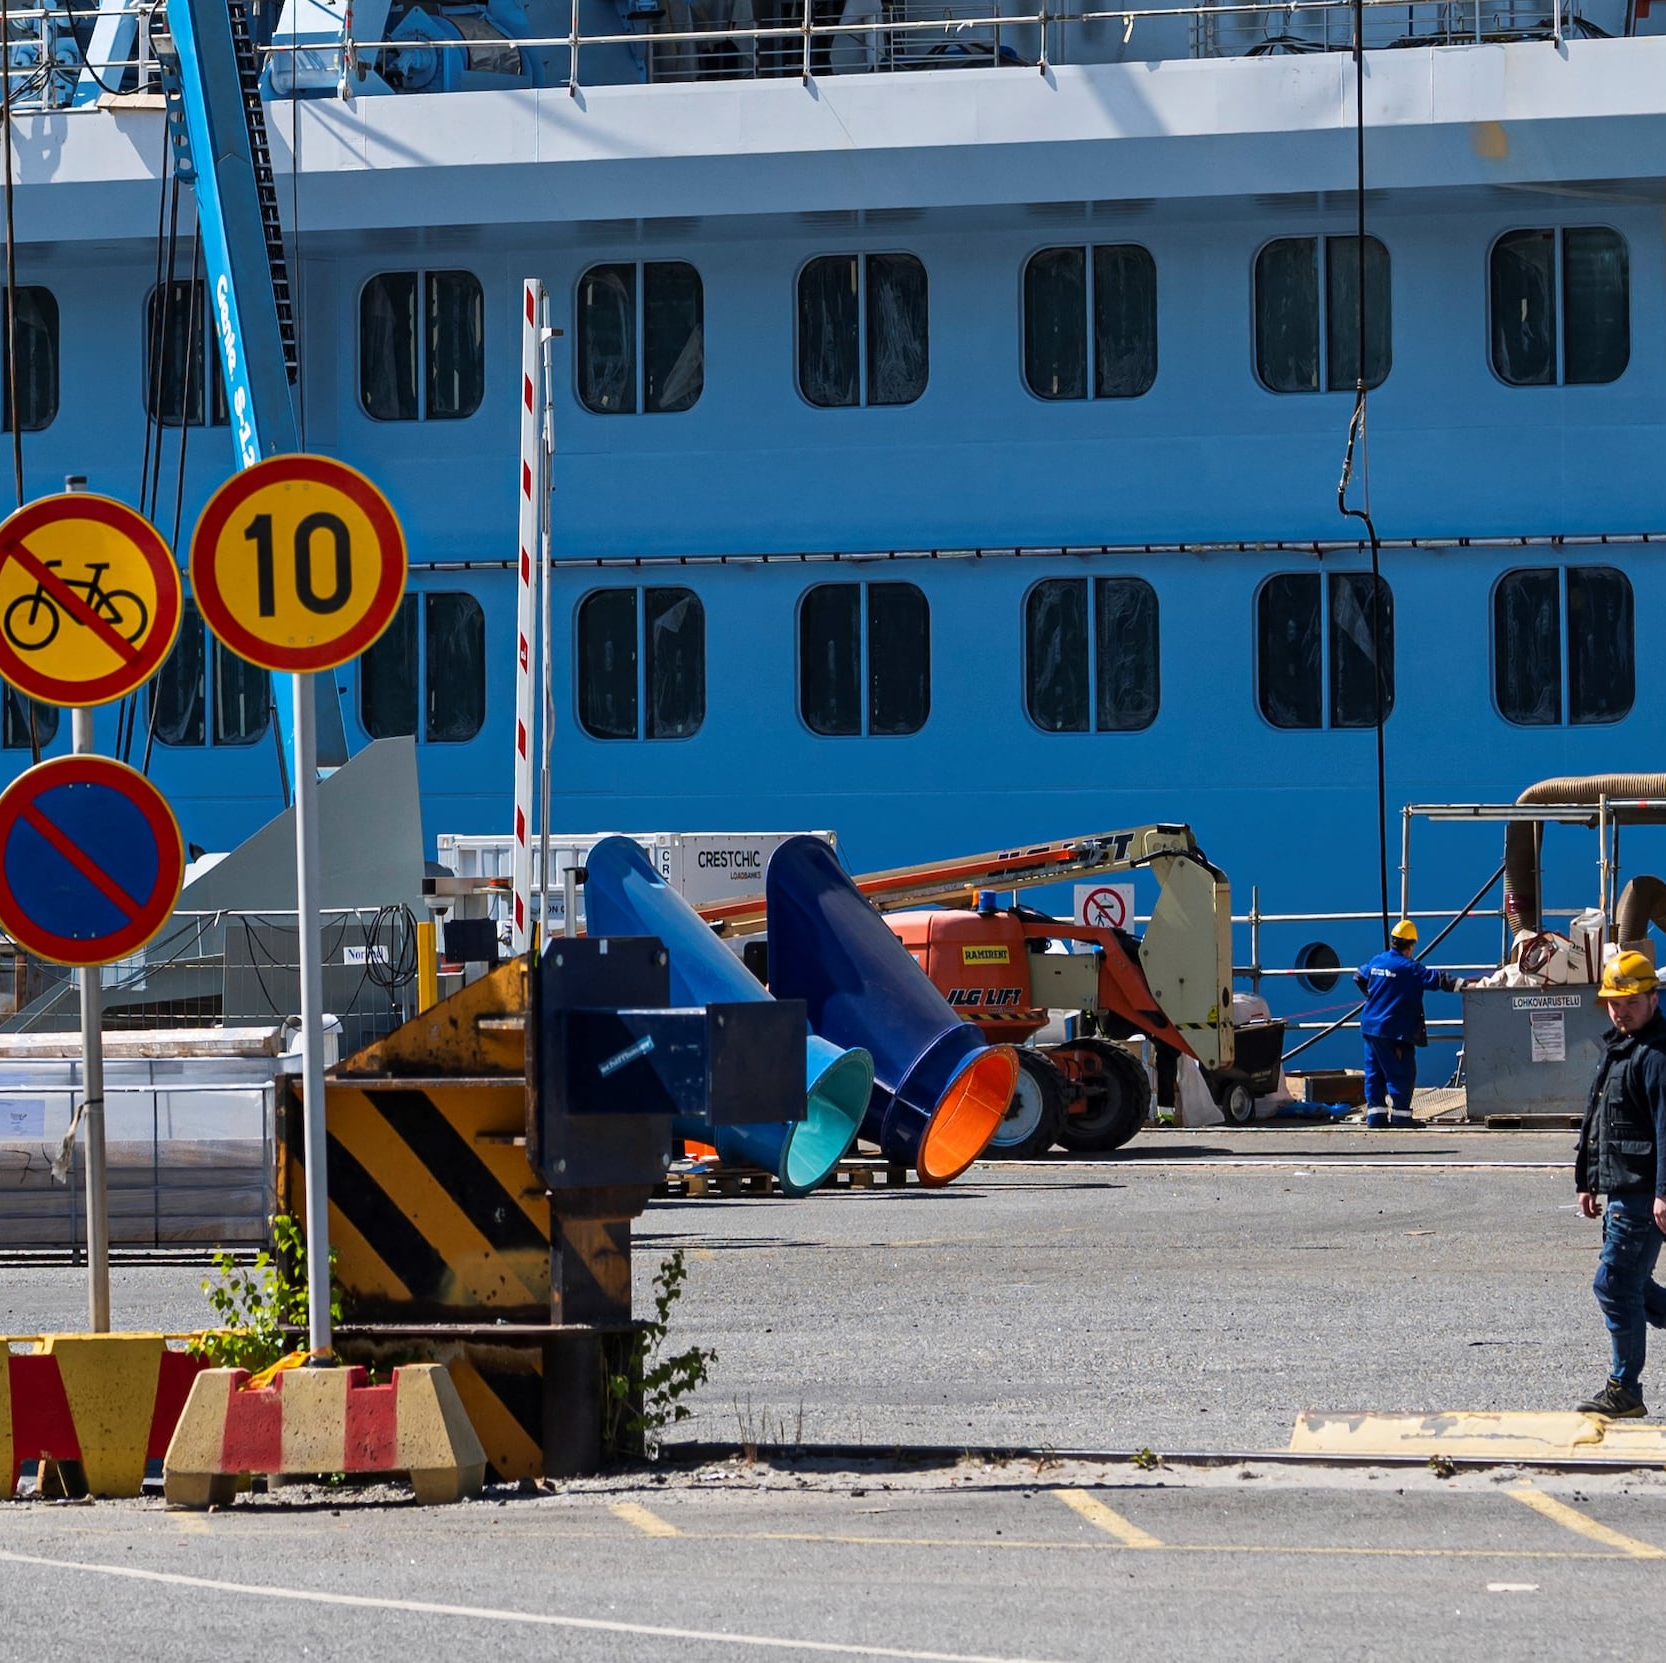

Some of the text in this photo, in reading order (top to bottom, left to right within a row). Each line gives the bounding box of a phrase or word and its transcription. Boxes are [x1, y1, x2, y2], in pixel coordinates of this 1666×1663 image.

[244, 511, 352, 617] 10
[697, 850, 761, 868] CRESTCHIC
[964, 949, 1008, 960] RAMIRENT
[947, 988, 1022, 1006] JLG LIFT
[1513, 996, 1580, 1008] LOHKOVARUSTELU
